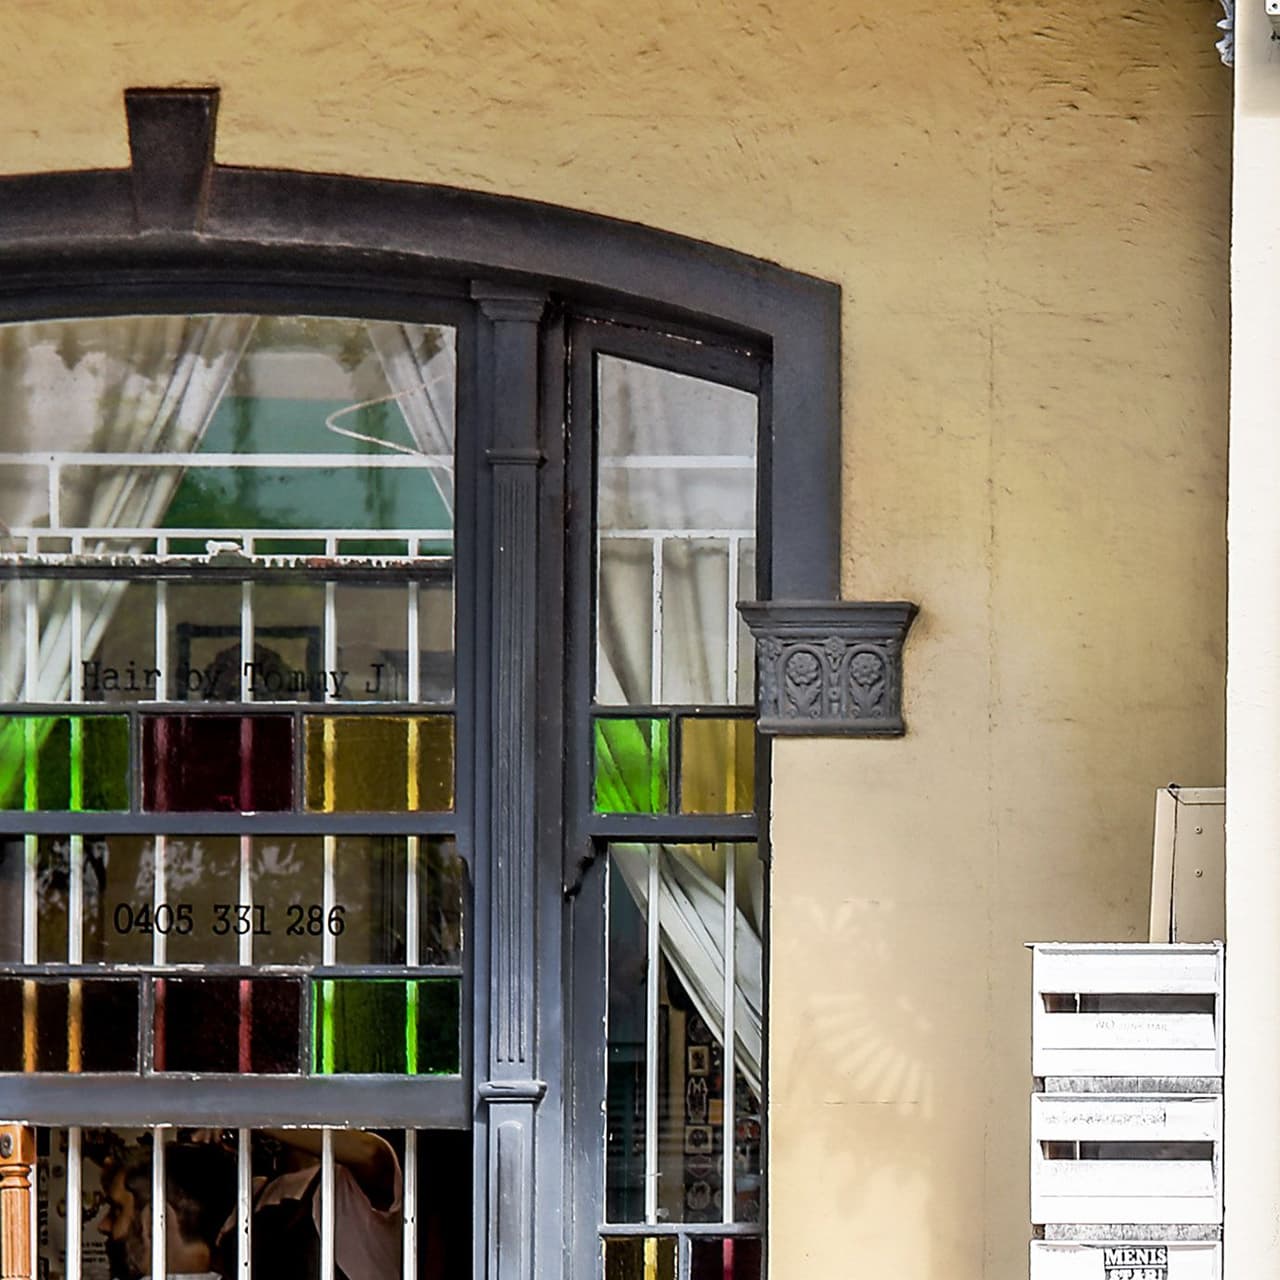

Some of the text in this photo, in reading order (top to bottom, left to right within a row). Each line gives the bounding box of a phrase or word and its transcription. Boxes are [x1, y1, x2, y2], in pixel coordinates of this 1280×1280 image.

[81, 660, 162, 692] Hair
[184, 660, 223, 698] by
[113, 902, 347, 936] 0405 331 286
